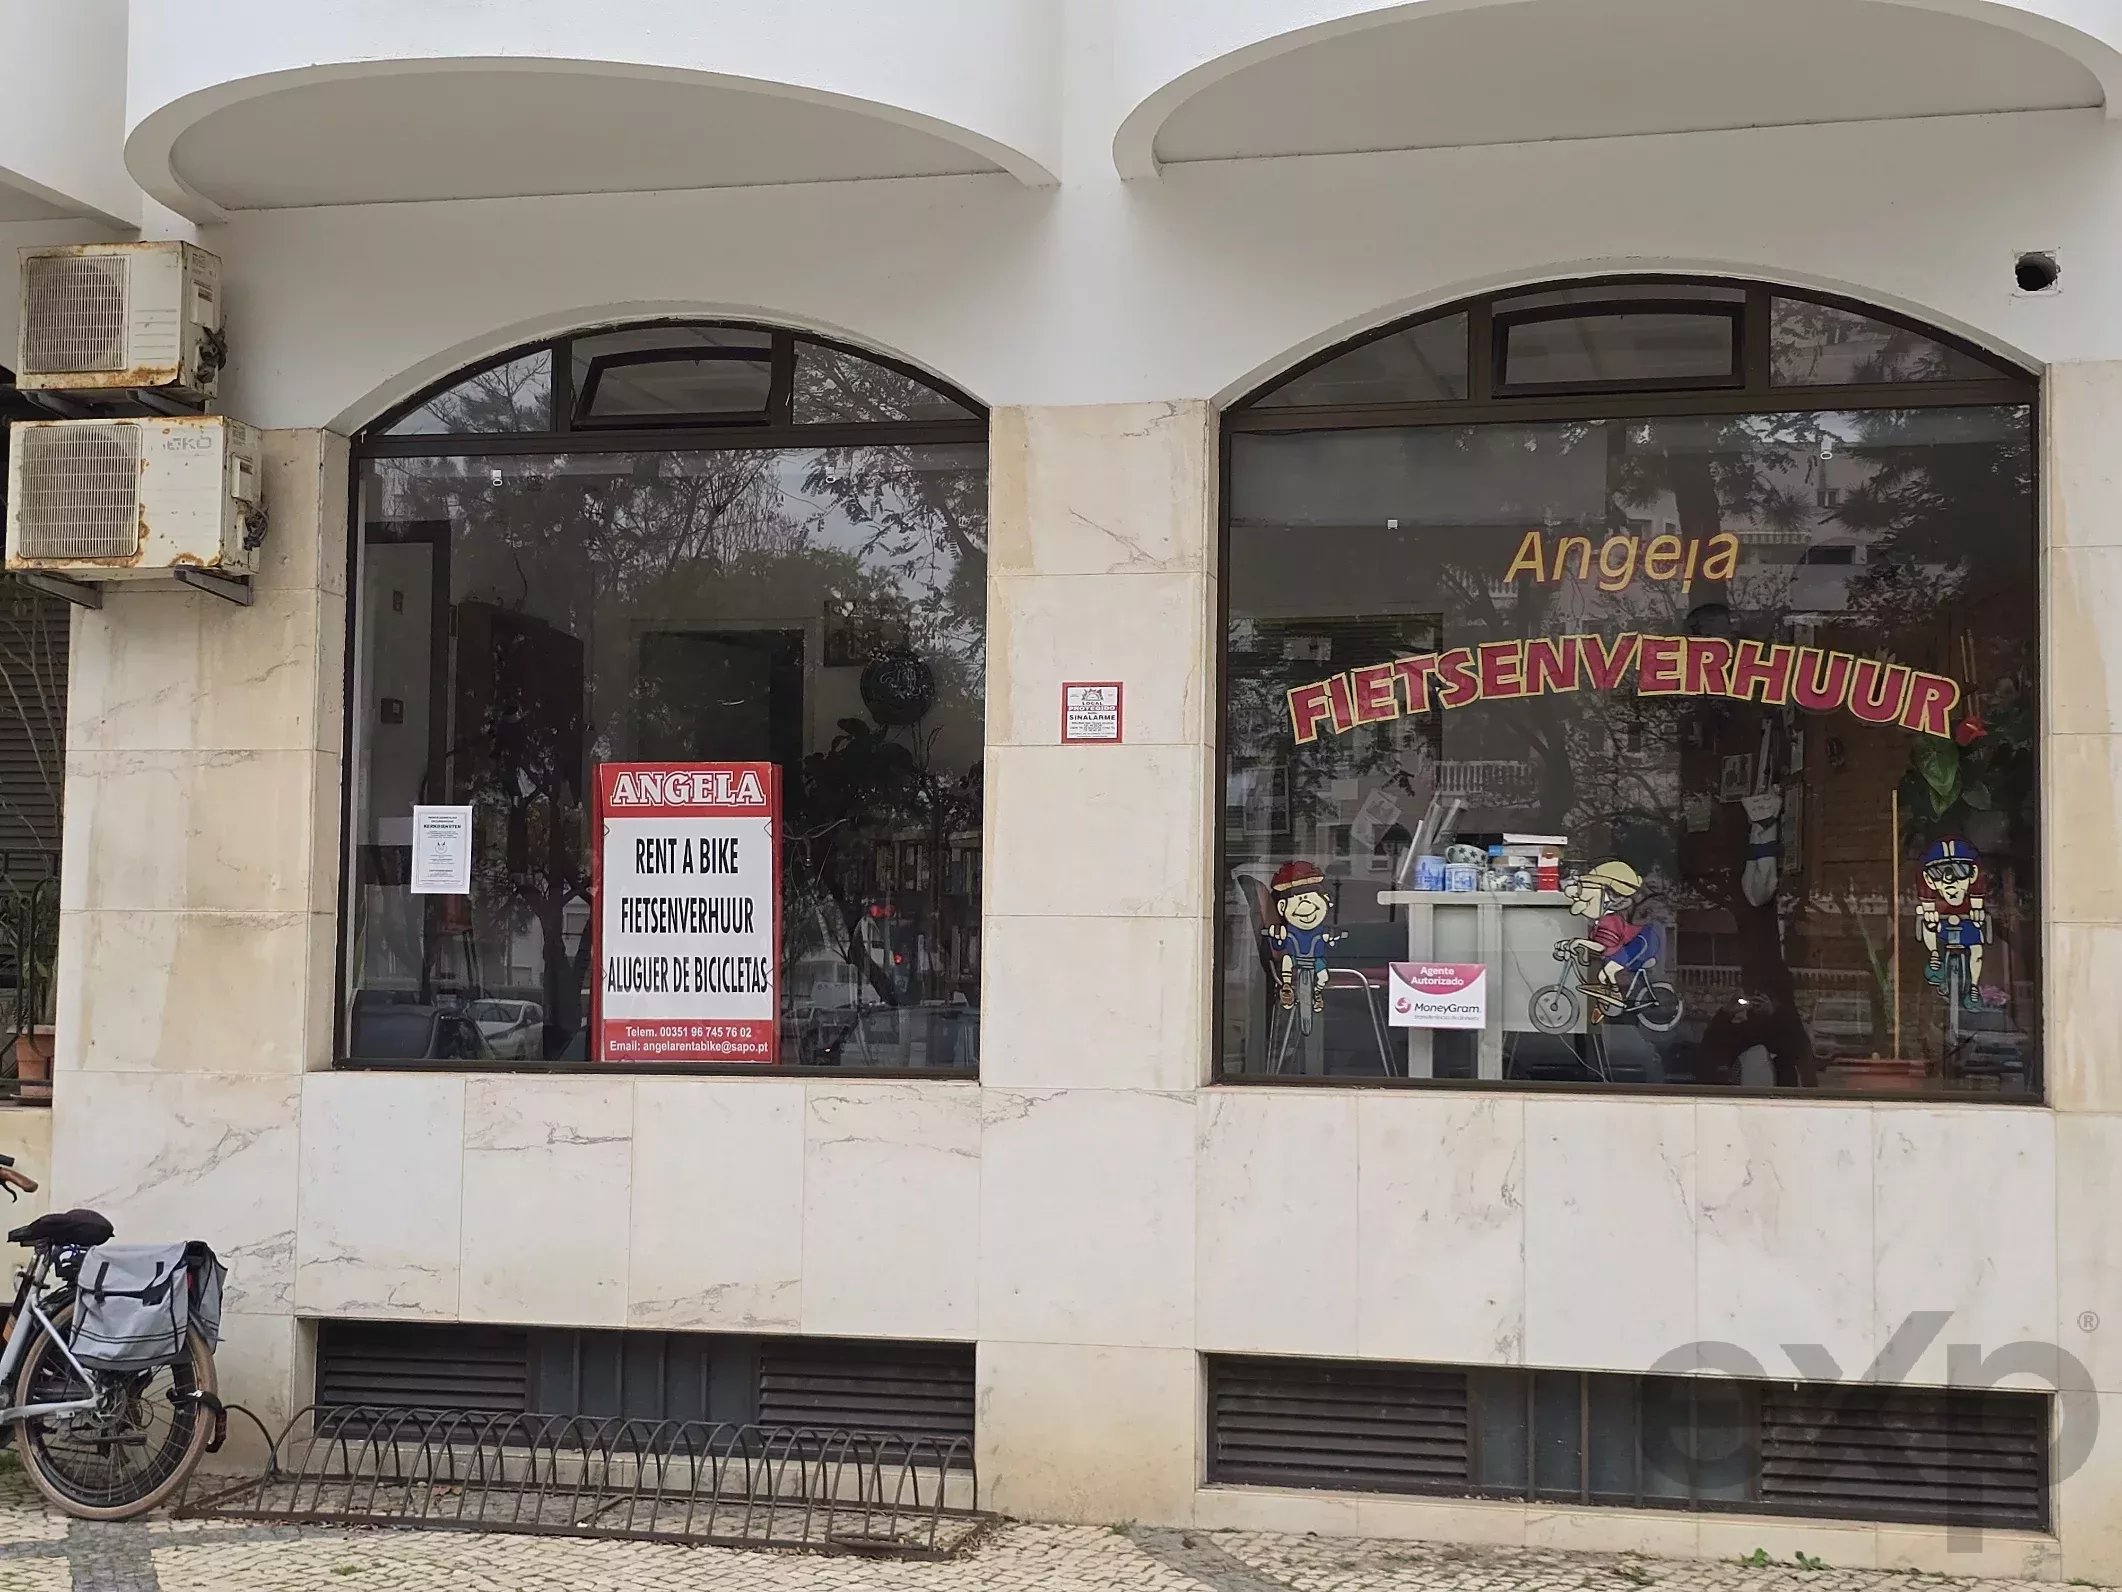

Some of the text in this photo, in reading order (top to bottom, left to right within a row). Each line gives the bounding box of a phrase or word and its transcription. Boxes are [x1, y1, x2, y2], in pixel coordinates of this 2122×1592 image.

[1503, 530, 1740, 594] Angela
[1287, 632, 1960, 745] FIETSENVERHUUR
[610, 770, 767, 807] ANGELA
[636, 838, 739, 874] RENT A BIKE
[621, 897, 754, 934] FIETSENVERHUUR
[607, 956, 768, 993] ALUGUER DE BICICLETAS
[1411, 976, 1465, 986] Autorizado
[1420, 966, 1455, 977] Agente
[1414, 1002, 1480, 1014] MoneyGram
[609, 1040, 769, 1054] Email: angelarentabike@sapo.pt
[625, 1026, 752, 1038] Telem. 00351 96 745 76 02
